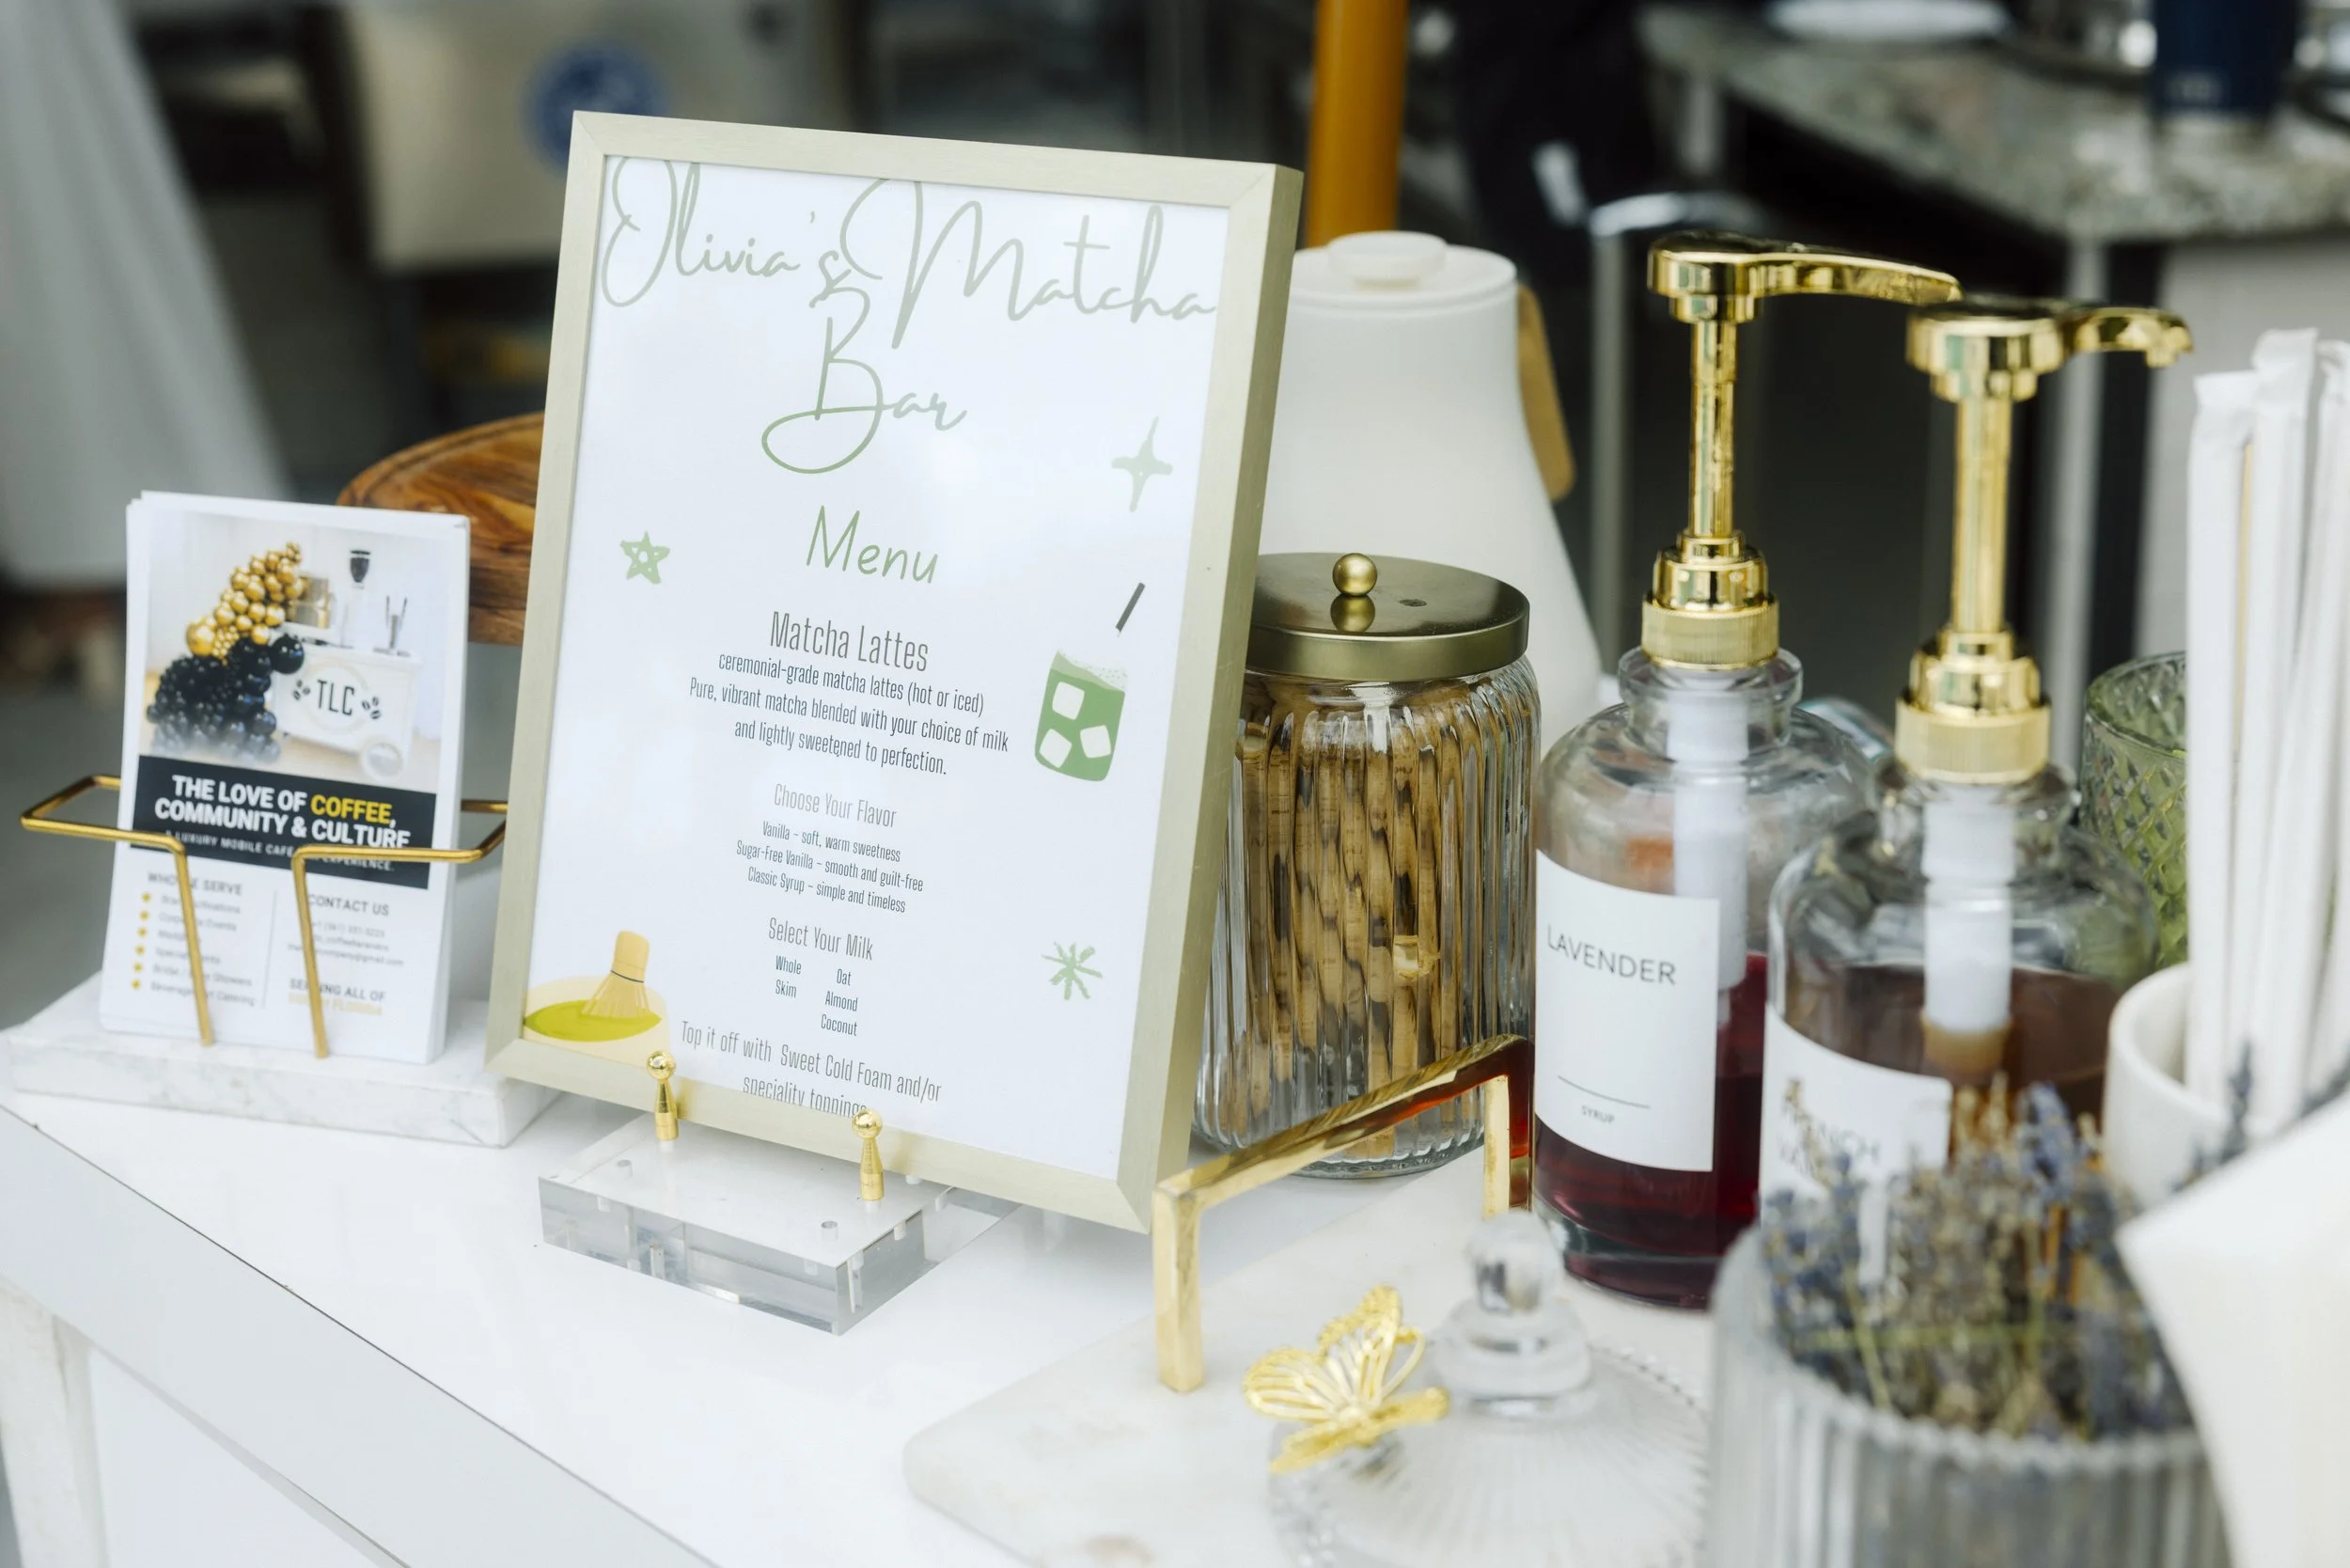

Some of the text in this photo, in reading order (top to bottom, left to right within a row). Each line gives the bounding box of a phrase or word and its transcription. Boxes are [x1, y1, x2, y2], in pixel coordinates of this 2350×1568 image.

[602, 156, 1216, 349] Olivia's Matcha
[761, 285, 969, 474] Bar
[807, 506, 938, 584] Menu
[770, 610, 929, 672] Matcha Lattes
[316, 680, 356, 716] TLC
[718, 653, 984, 717] ceremonial-grade matcha lattes (hot or iced)
[690, 677, 1009, 752] Pure, vibrant matcha blended with your choice of milk
[734, 719, 947, 775] and lightly sweetened to perfection.
[155, 797, 289, 834] COMMUNITY
[290, 818, 306, 838] &
[172, 775, 396, 827] THE LOVE OF COFFEE,
[774, 783, 897, 828] Choose Your Flavor
[175, 833, 218, 846] LUXURY
[220, 838, 261, 853] MOBILE
[762, 821, 790, 840] Vanilla
[802, 830, 822, 847] soft,
[825, 838, 850, 852] warm
[853, 840, 901, 863] sweetness
[203, 880, 243, 896] SERVE
[736, 840, 783, 864] Sugar-Free
[786, 850, 813, 870] Vanilla
[825, 860, 858, 878] smooth
[861, 865, 877, 883] and
[880, 870, 923, 892] guilt-free
[308, 895, 389, 916] CONTACT US
[747, 867, 776, 886] Classic
[780, 874, 805, 894] Syrup
[816, 881, 845, 901] simple
[848, 886, 864, 904] and
[868, 892, 905, 914] timeless
[768, 917, 872, 961] Select Your Milk
[1546, 924, 1677, 987] LAVENDER
[776, 955, 852, 986] Whole Oat
[776, 980, 797, 998] Skim
[345, 987, 366, 999] ALL
[370, 991, 386, 1002] OF
[824, 991, 858, 1011] Almond
[821, 1013, 858, 1036] Coconut
[682, 1021, 941, 1103] Top it off with Sweet Cold Foam and/or
[1580, 1104, 1616, 1125] SYRUP
